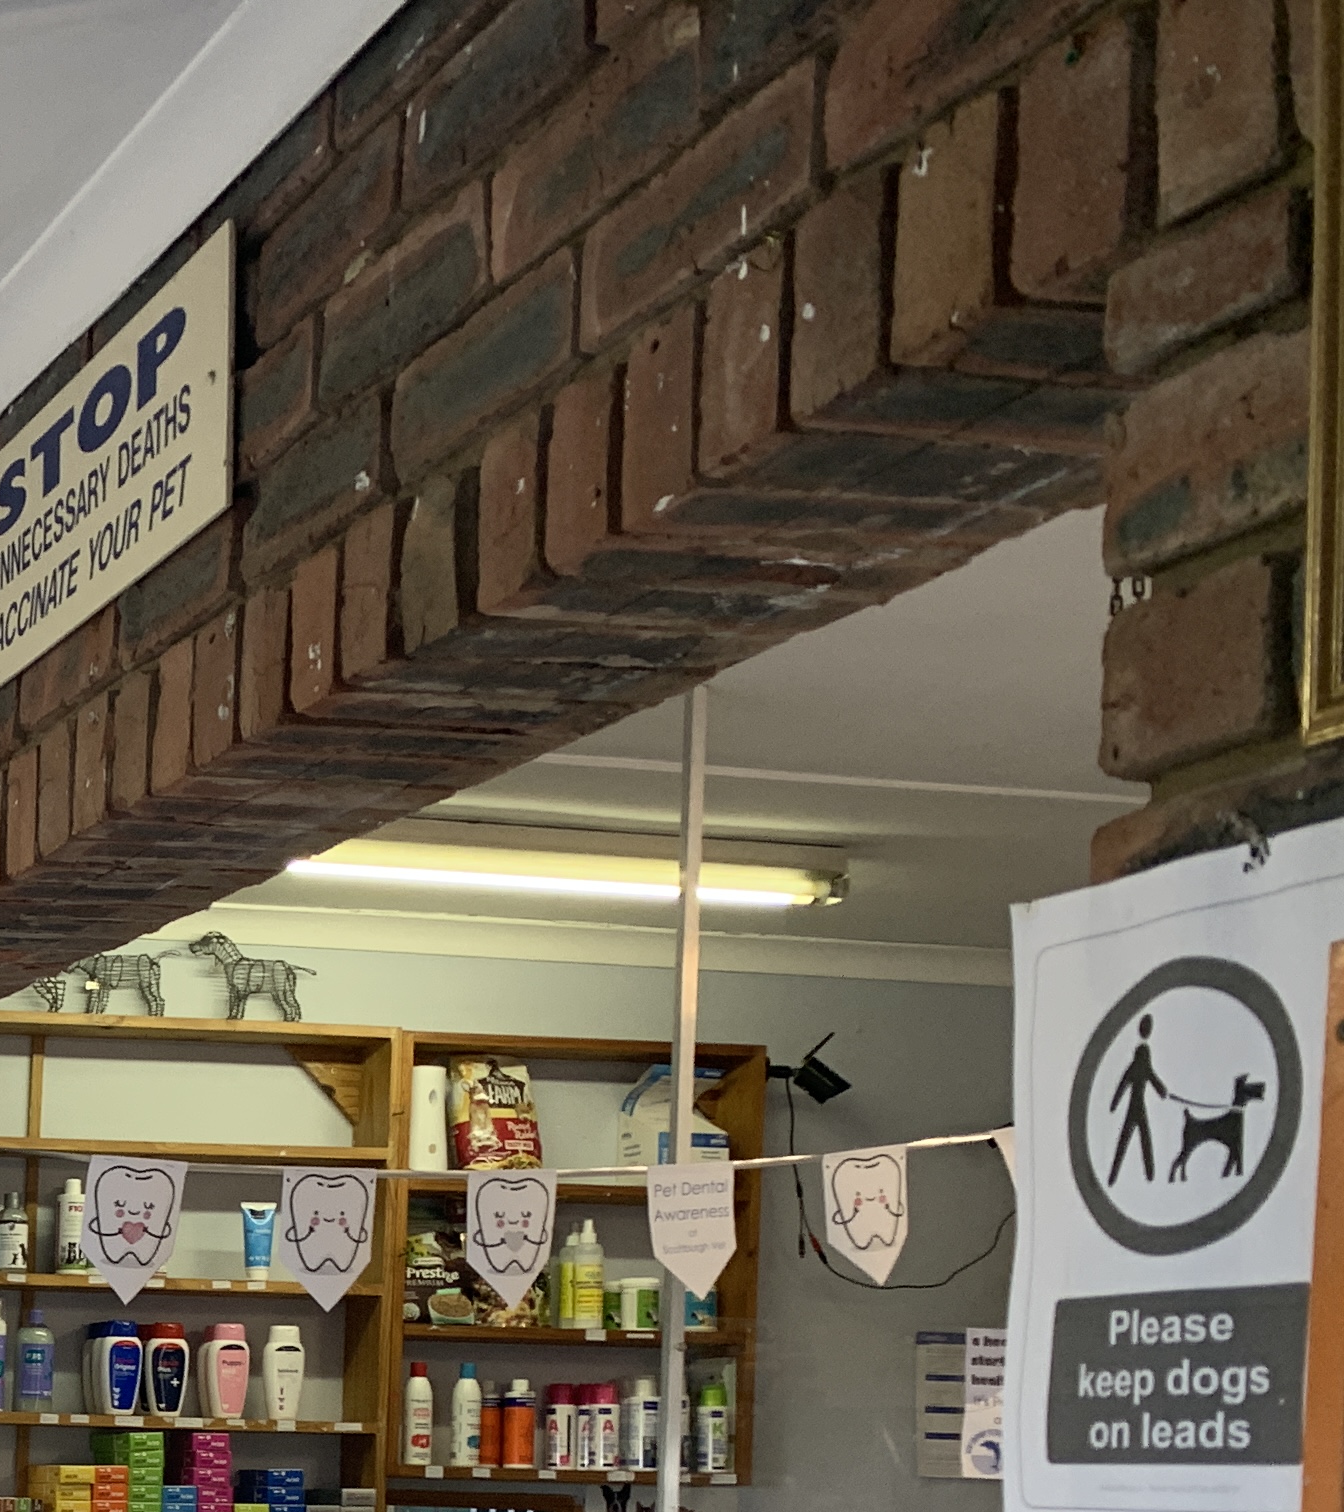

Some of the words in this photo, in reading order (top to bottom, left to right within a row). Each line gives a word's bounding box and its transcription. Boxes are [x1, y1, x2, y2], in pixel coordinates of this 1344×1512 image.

[117, 383, 191, 489] DEATHS
[89, 496, 141, 581] YOUR
[148, 454, 193, 532] PET
[654, 1184, 677, 1198] Pet
[681, 1179, 728, 1195] Dental
[654, 1206, 730, 1222] Awareness
[1108, 1308, 1235, 1346] Please
[1077, 1363, 1155, 1406] keep
[1166, 1358, 1271, 1405] dogs
[1089, 1419, 1130, 1450] on
[1142, 1410, 1251, 1450] leads
